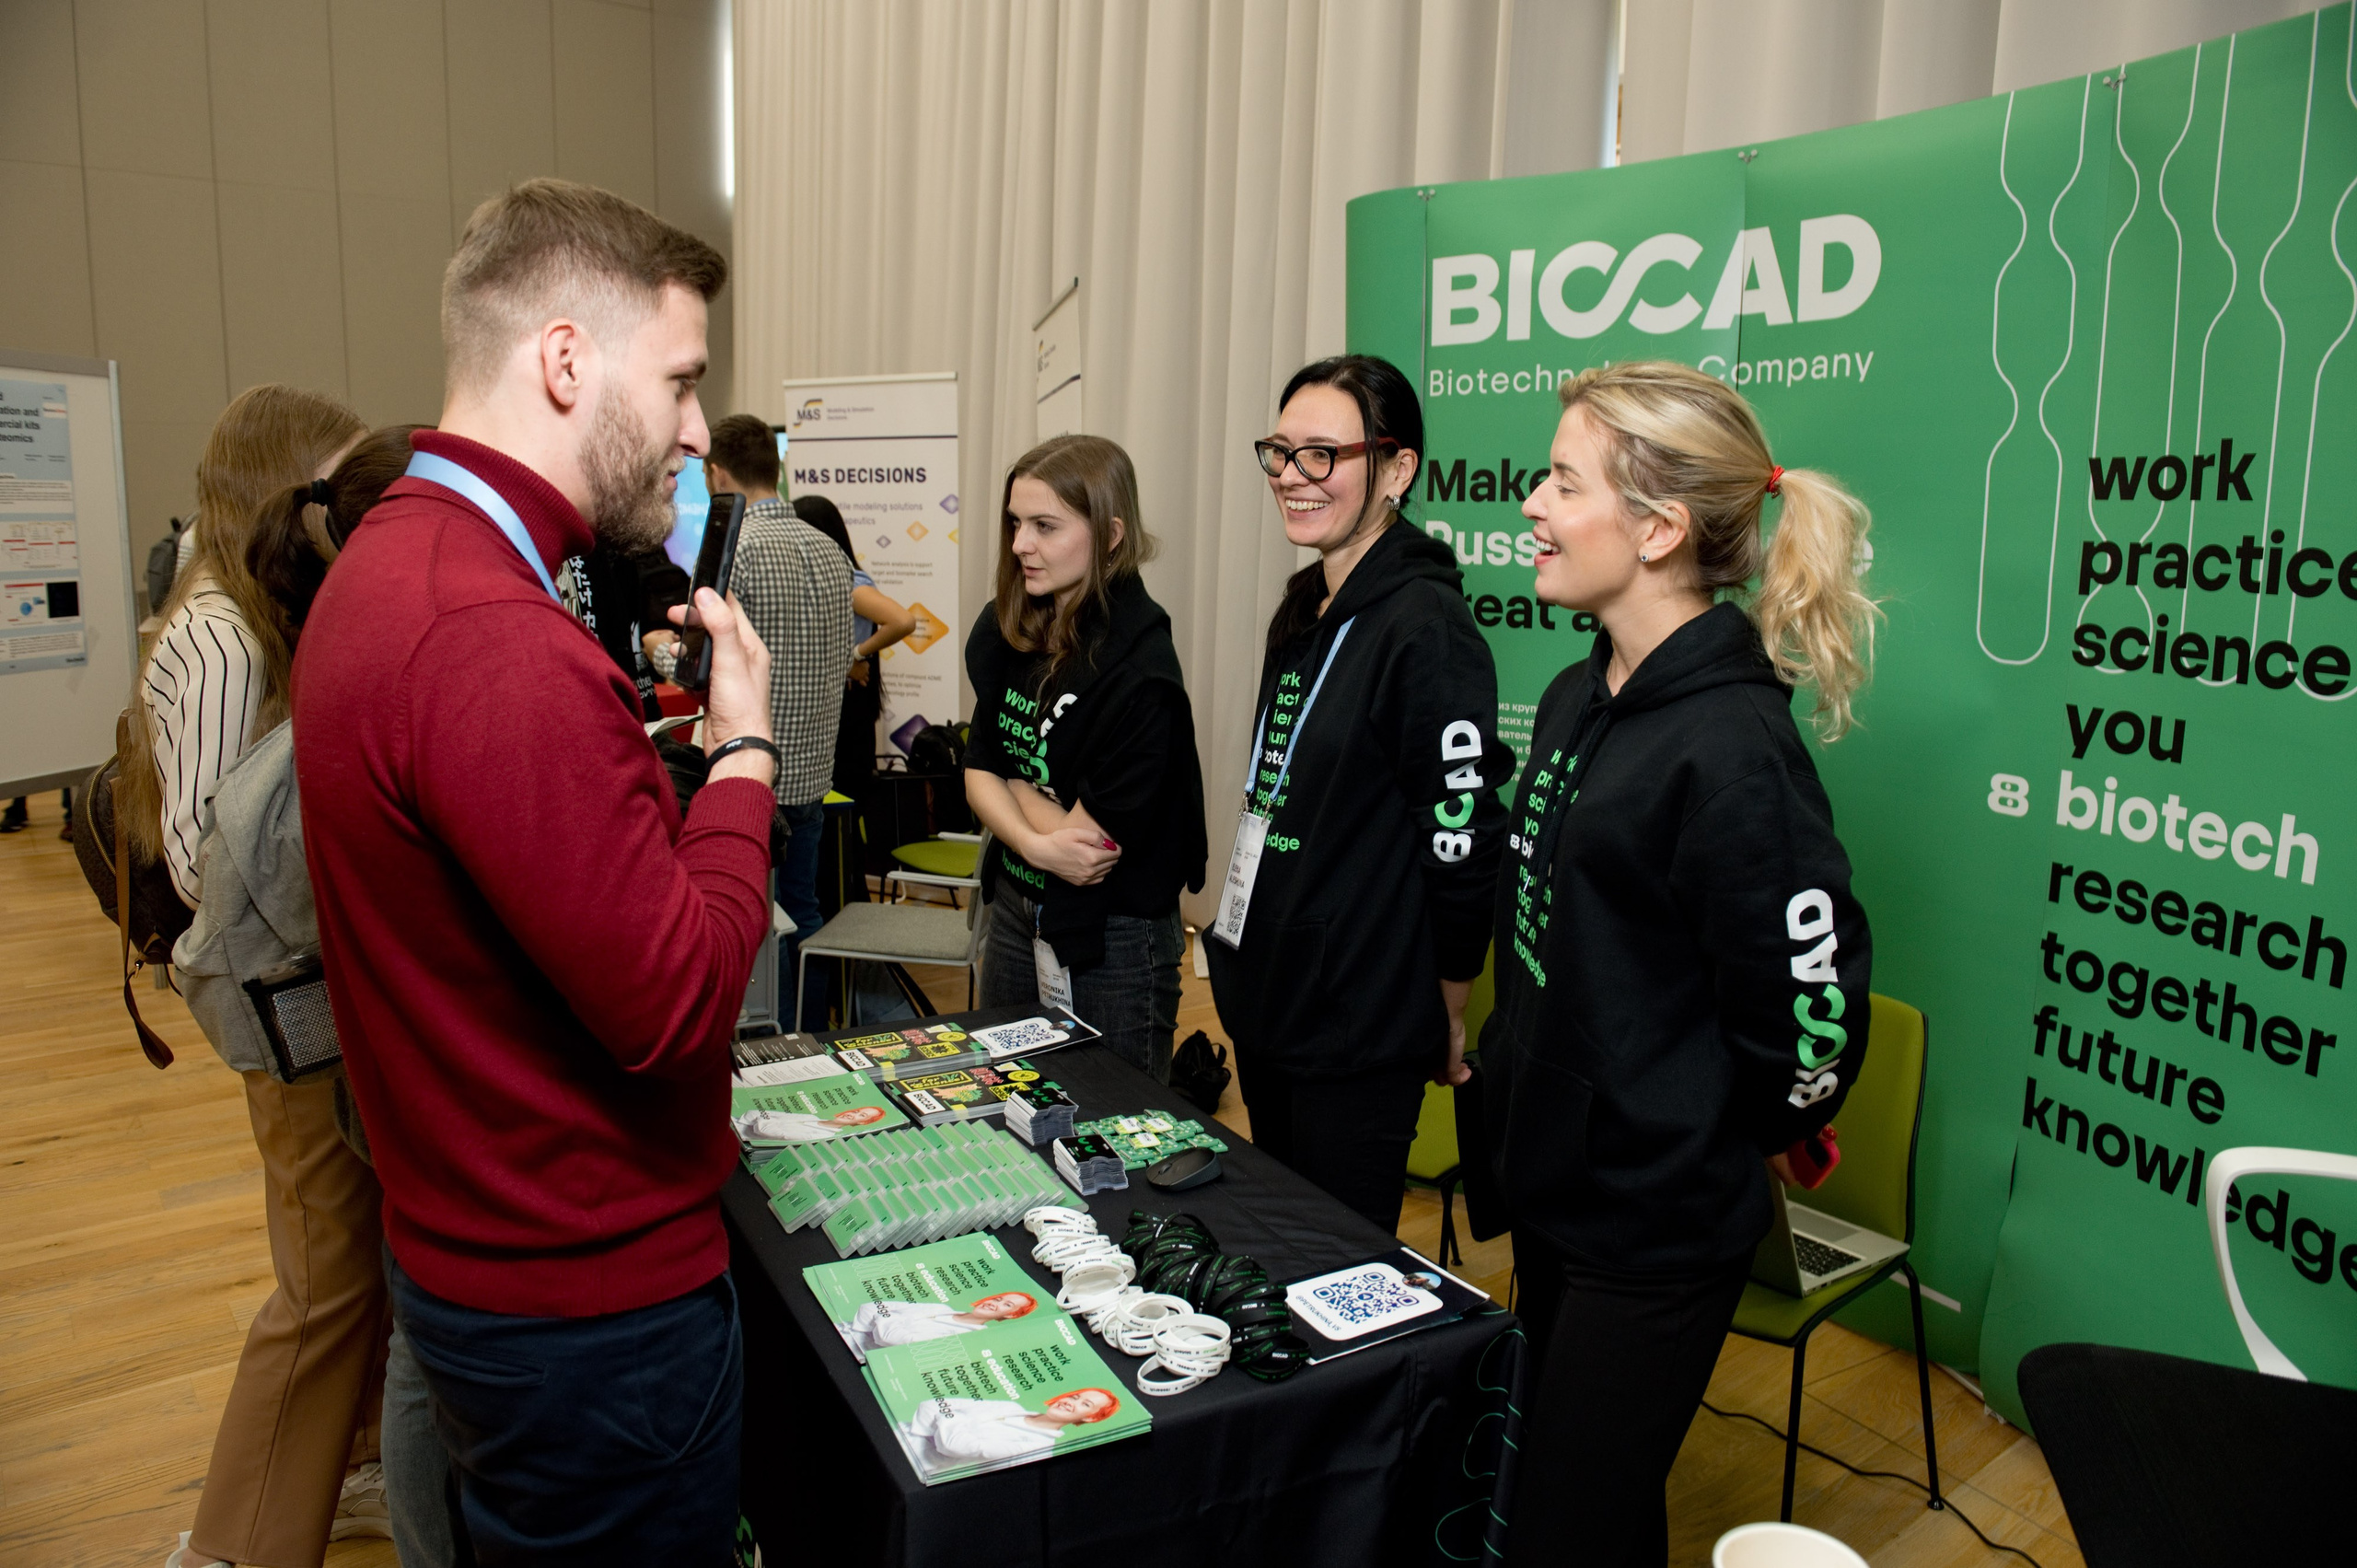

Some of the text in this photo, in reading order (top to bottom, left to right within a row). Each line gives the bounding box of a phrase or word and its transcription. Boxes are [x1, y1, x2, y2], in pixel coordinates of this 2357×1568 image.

[1430, 214, 1882, 347] BIOCAD
[1430, 351, 1875, 397] Biotechn Company
[23, 408, 39, 416] and
[25, 421, 41, 430] kits
[796, 409, 820, 421] M&S
[795, 467, 926, 483] M&S DECISIONS
[2088, 437, 2257, 502] work
[845, 517, 876, 526] apeutics
[853, 502, 888, 513] modeling
[889, 503, 923, 511] solutions
[568, 555, 593, 608] はたけ
[2072, 613, 2351, 696] science
[1498, 703, 1538, 714] из круп
[1498, 716, 1521, 726] ских
[1497, 730, 1532, 740] ватель
[2066, 703, 2187, 764] you
[2056, 769, 2319, 886] biotech
[2048, 861, 2348, 990] research
[2040, 930, 2338, 1078] together
[2033, 1005, 2225, 1125] future
[935, 1266, 963, 1296] research
[948, 1263, 973, 1290] science
[960, 1260, 989, 1288] practice
[977, 1258, 995, 1275] work
[861, 1280, 891, 1318] knowledge
[877, 1277, 896, 1299] future
[891, 1274, 917, 1305] together
[906, 1271, 931, 1299] biotech
[921, 1270, 949, 1303] education
[1054, 1318, 1076, 1346] BIOCAD
[1018, 1351, 1046, 1384] science
[1032, 1348, 1064, 1382] practice
[1050, 1344, 1072, 1365] work
[937, 1368, 959, 1396] future
[954, 1365, 983, 1401] together
[970, 1361, 997, 1395] biotech
[987, 1358, 1020, 1400] education
[1002, 1354, 1034, 1391] research
[921, 1371, 955, 1419] knowledge
